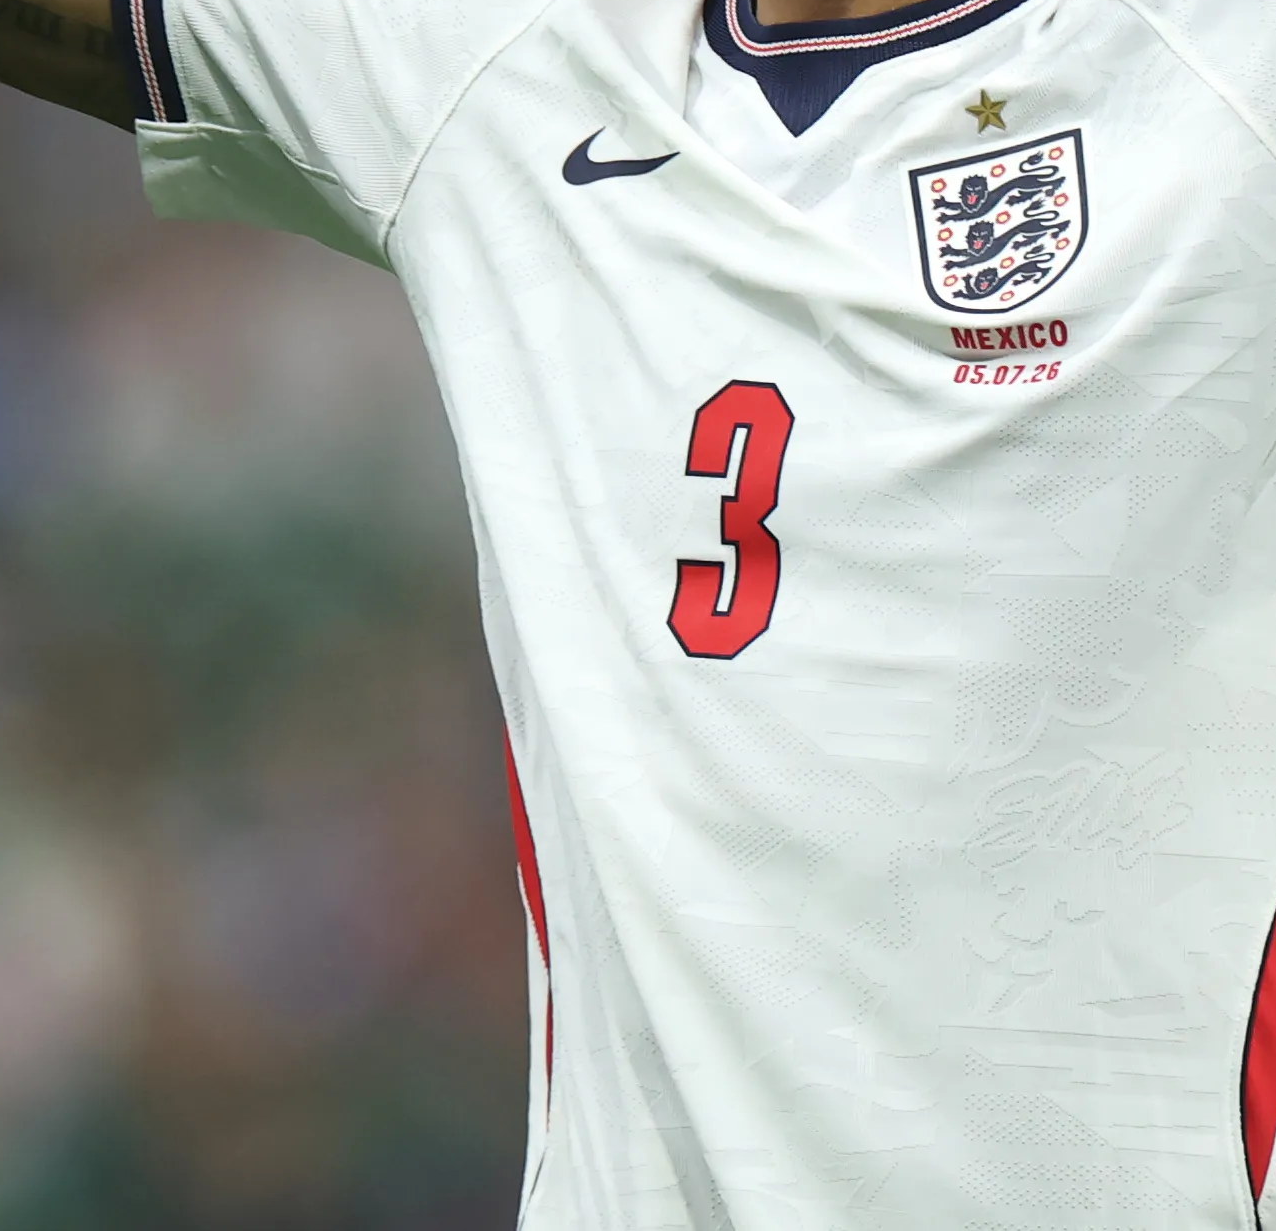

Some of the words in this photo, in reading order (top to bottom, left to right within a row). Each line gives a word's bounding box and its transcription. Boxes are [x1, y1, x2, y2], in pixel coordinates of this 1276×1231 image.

[951, 320, 1068, 350] MEXICO
[953, 361, 1062, 386] 05.07.26
[667, 379, 795, 660] 3
